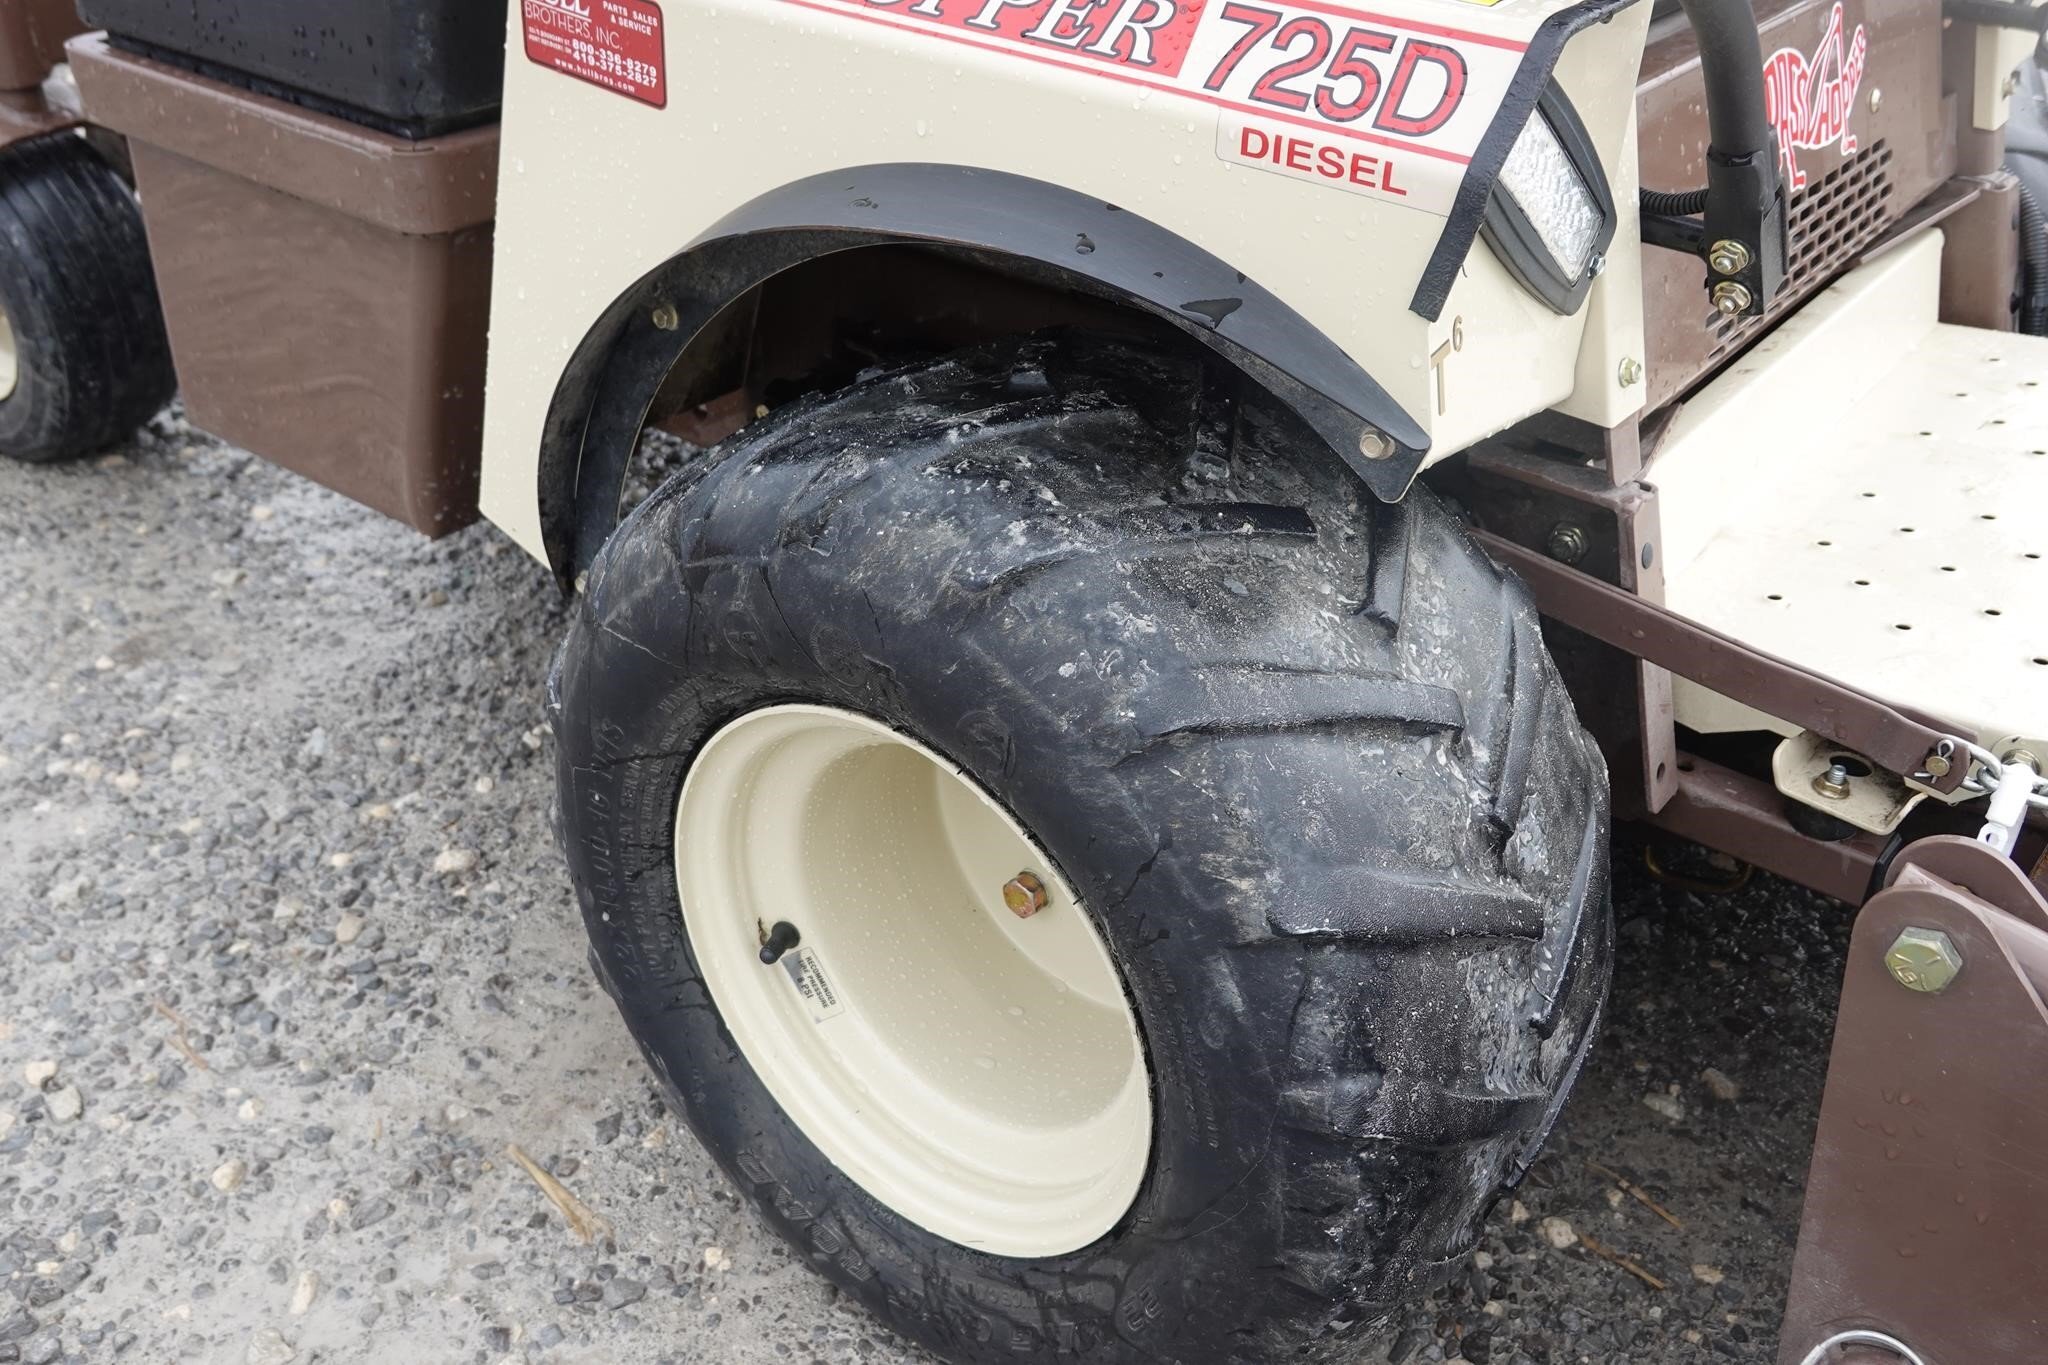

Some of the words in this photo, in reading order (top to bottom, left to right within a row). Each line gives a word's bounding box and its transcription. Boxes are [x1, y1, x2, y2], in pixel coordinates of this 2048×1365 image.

[525, 1, 593, 41] BROTHERS,
[596, 26, 624, 52] INC.
[602, 0, 628, 17] PARTS
[632, 10, 658, 27] SALES
[618, 16, 652, 36] SERVICE
[573, 50, 658, 88] 419-375-2827
[1203, 1, 1468, 137] 725D
[1240, 126, 1407, 196] DIESEL
[805, 955, 837, 1006] RECOMMENDED
